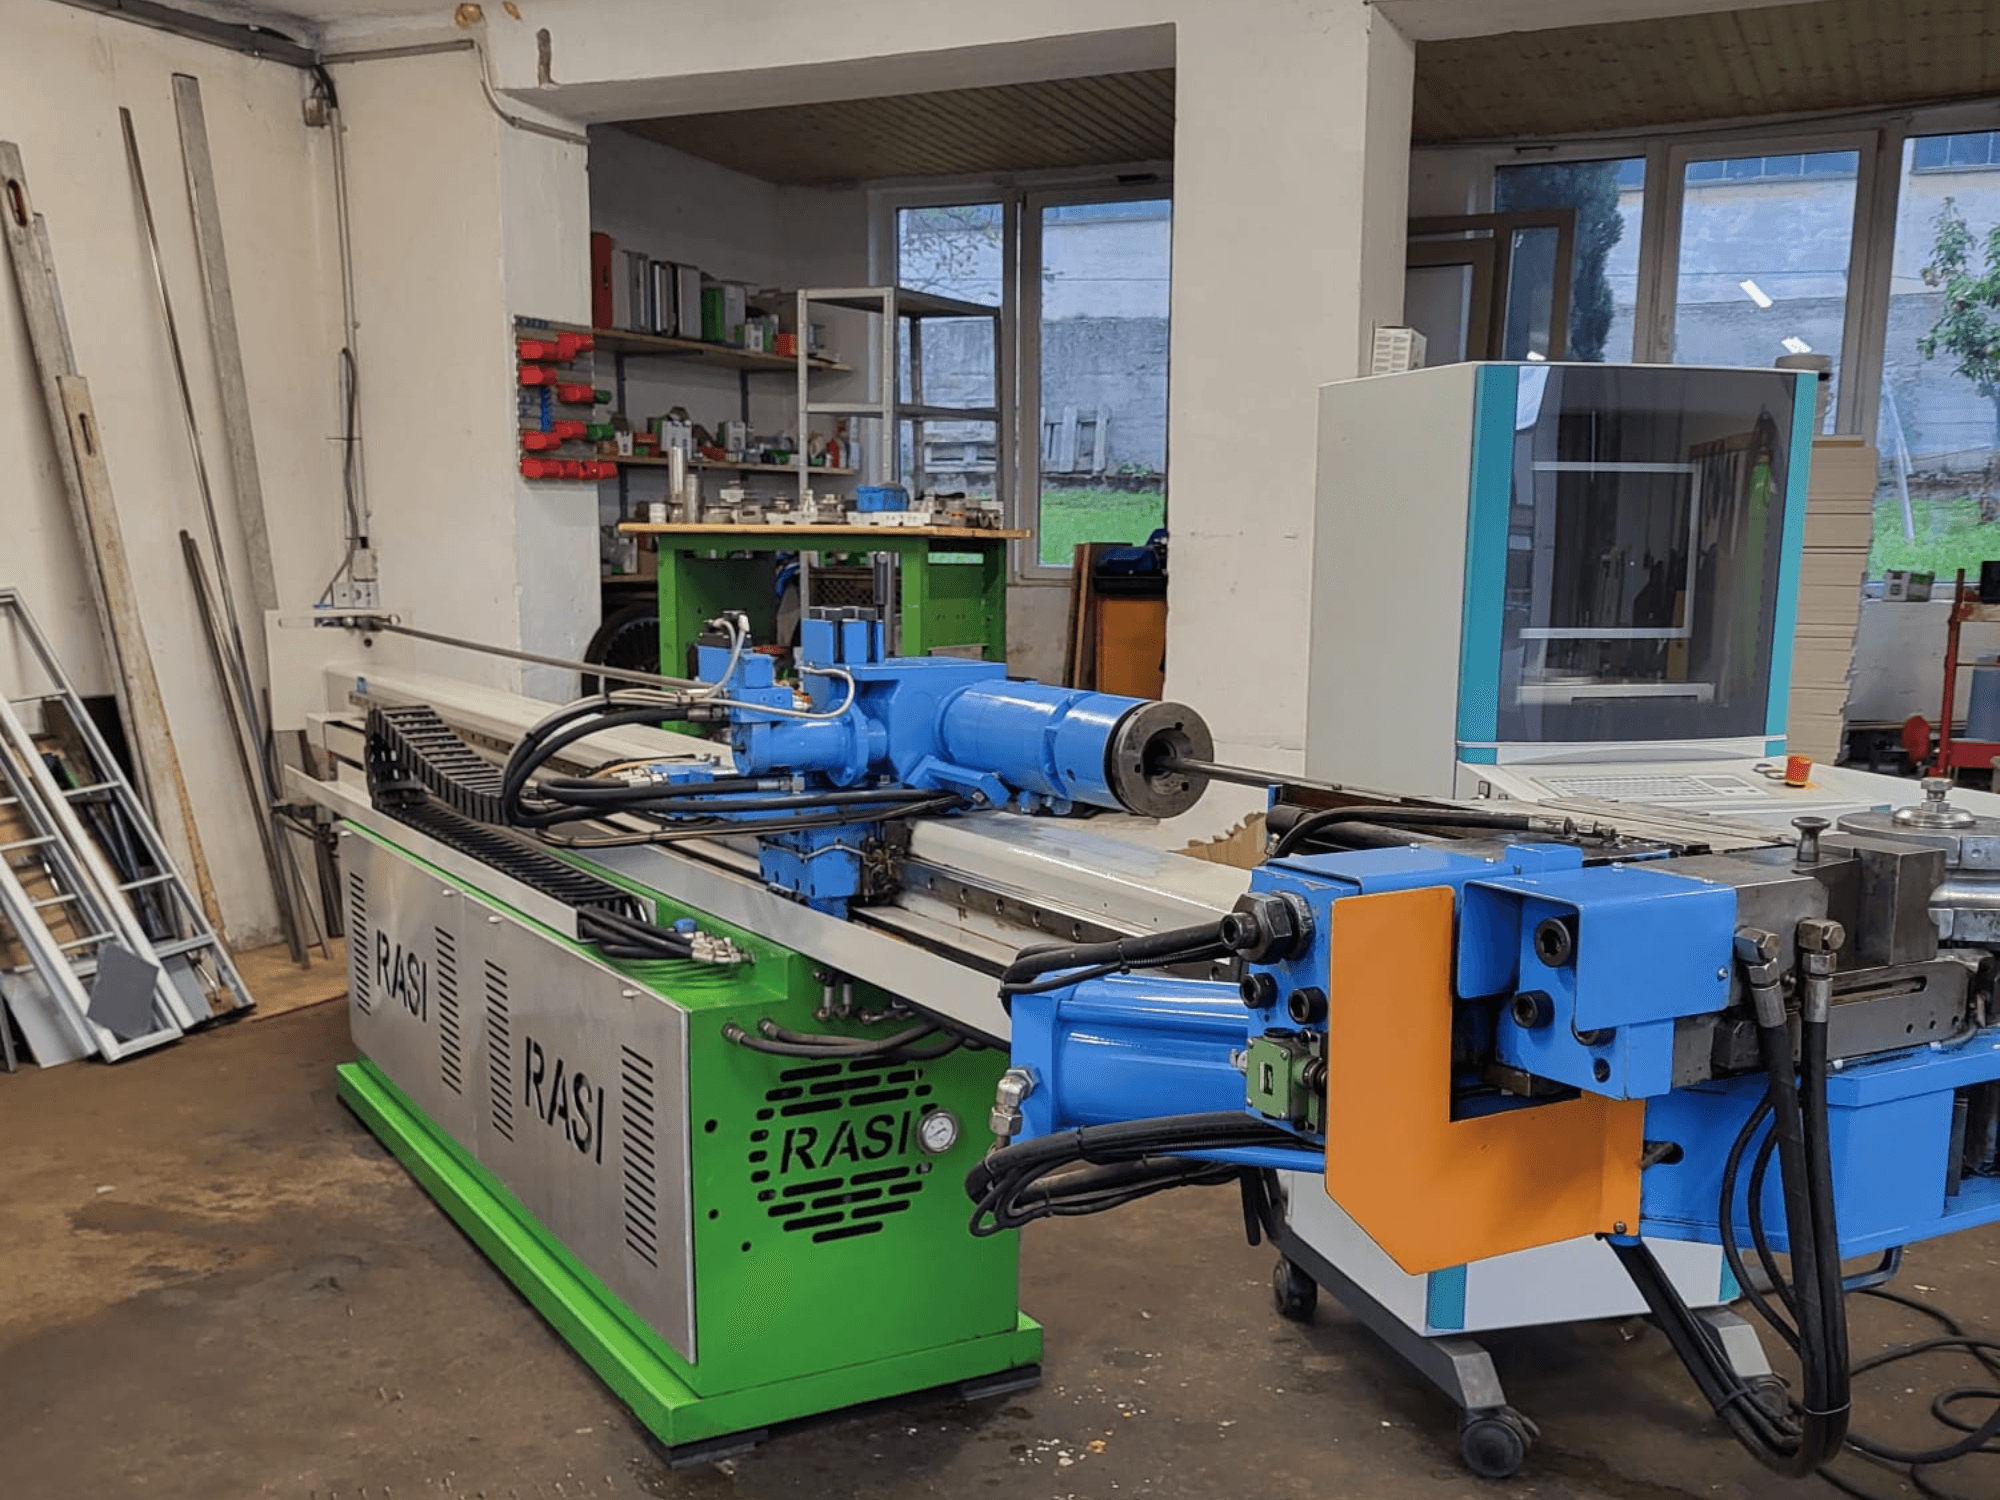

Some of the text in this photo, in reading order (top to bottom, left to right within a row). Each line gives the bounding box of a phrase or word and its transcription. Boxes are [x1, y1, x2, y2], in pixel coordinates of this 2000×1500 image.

[377, 929, 427, 1022] RASI
[525, 1035, 604, 1165] RASI
[780, 1111, 911, 1174] RASI
